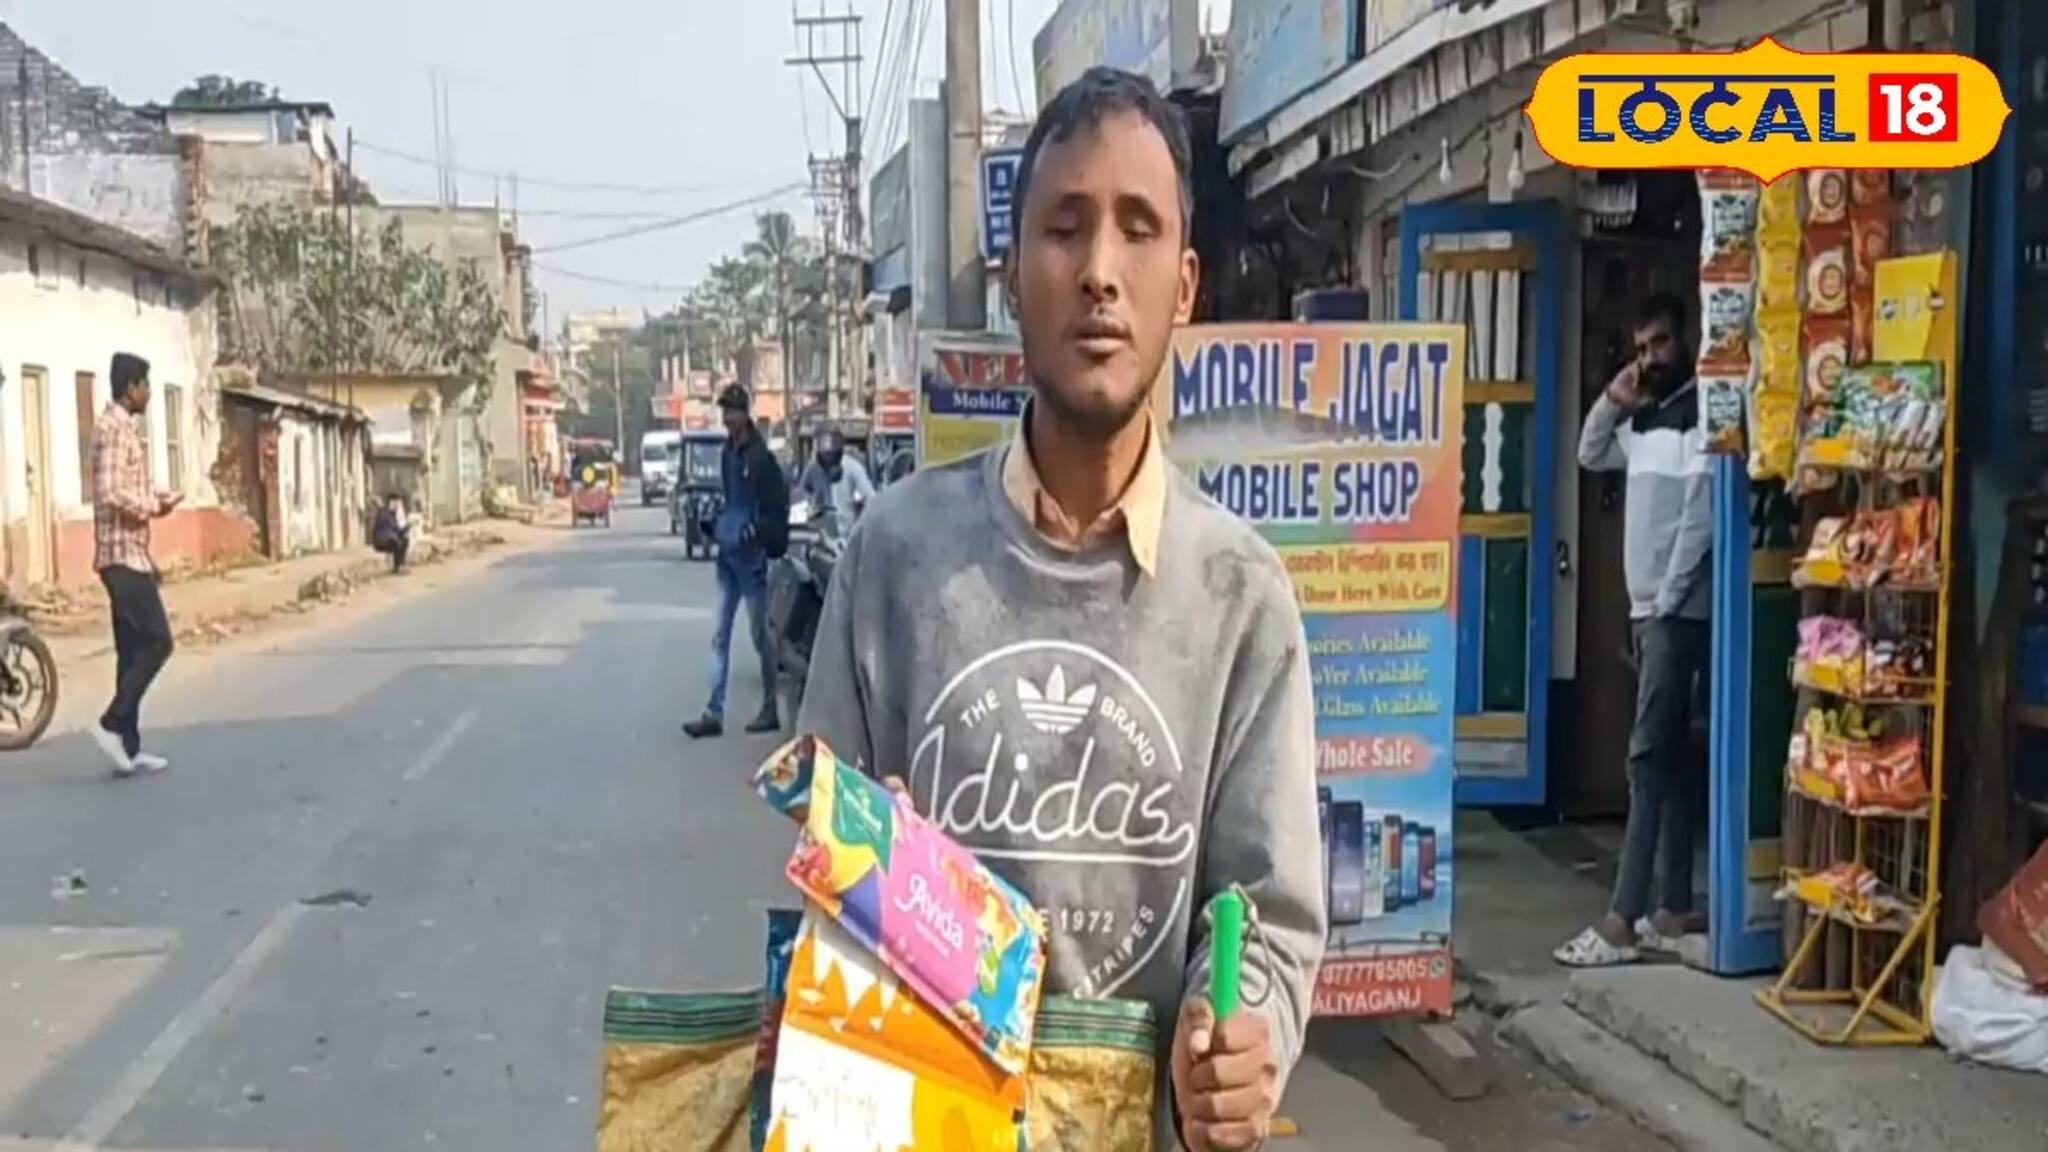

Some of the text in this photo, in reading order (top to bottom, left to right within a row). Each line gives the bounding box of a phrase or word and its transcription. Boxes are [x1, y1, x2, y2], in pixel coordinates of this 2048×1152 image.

[952, 391, 1012, 411] Mobile
[1329, 342, 1449, 441] JAGAT
[1199, 461, 1419, 519] MOBILE SHOP
[1359, 630, 1430, 652] Available
[1356, 661, 1429, 684] Available
[1371, 690, 1440, 715] Available
[958, 688, 1157, 768] THE BRAND
[1372, 737, 1412, 767] Sale
[909, 725, 1194, 847] Adidas
[1060, 907, 1115, 935] 1972
